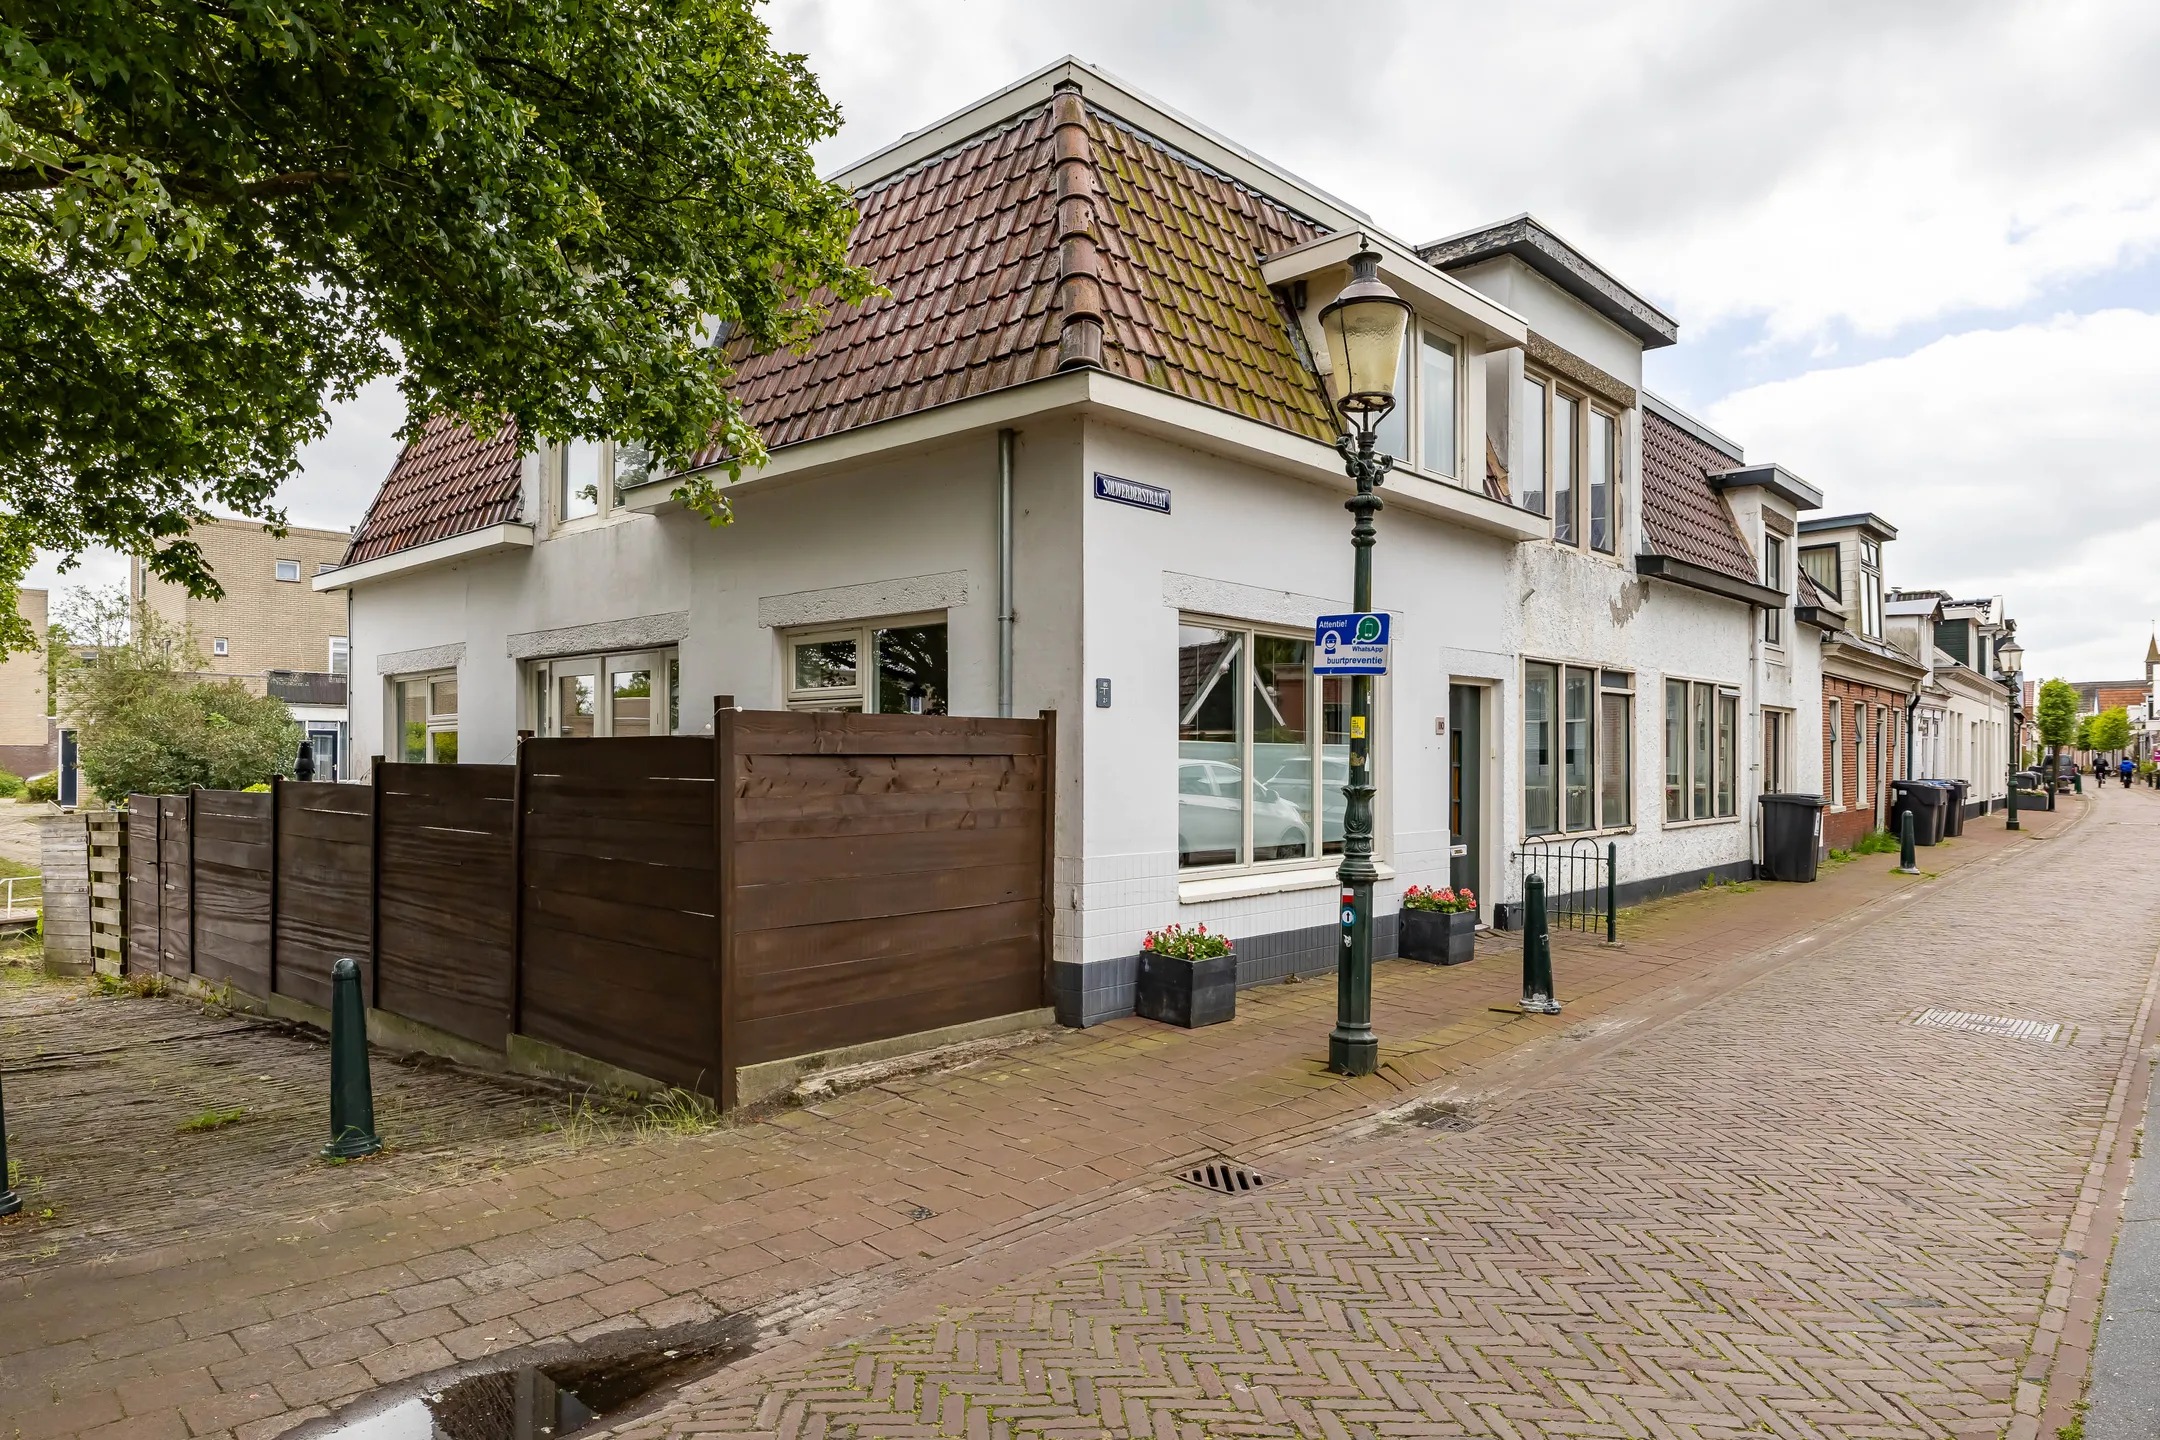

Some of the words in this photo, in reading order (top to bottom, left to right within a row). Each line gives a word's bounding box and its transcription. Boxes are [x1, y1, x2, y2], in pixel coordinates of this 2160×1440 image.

[1103, 479, 1166, 508] SOLWERDERSTRAAT
[1319, 620, 1347, 628] Attentie!
[1327, 656, 1383, 665] buurtpreventie
